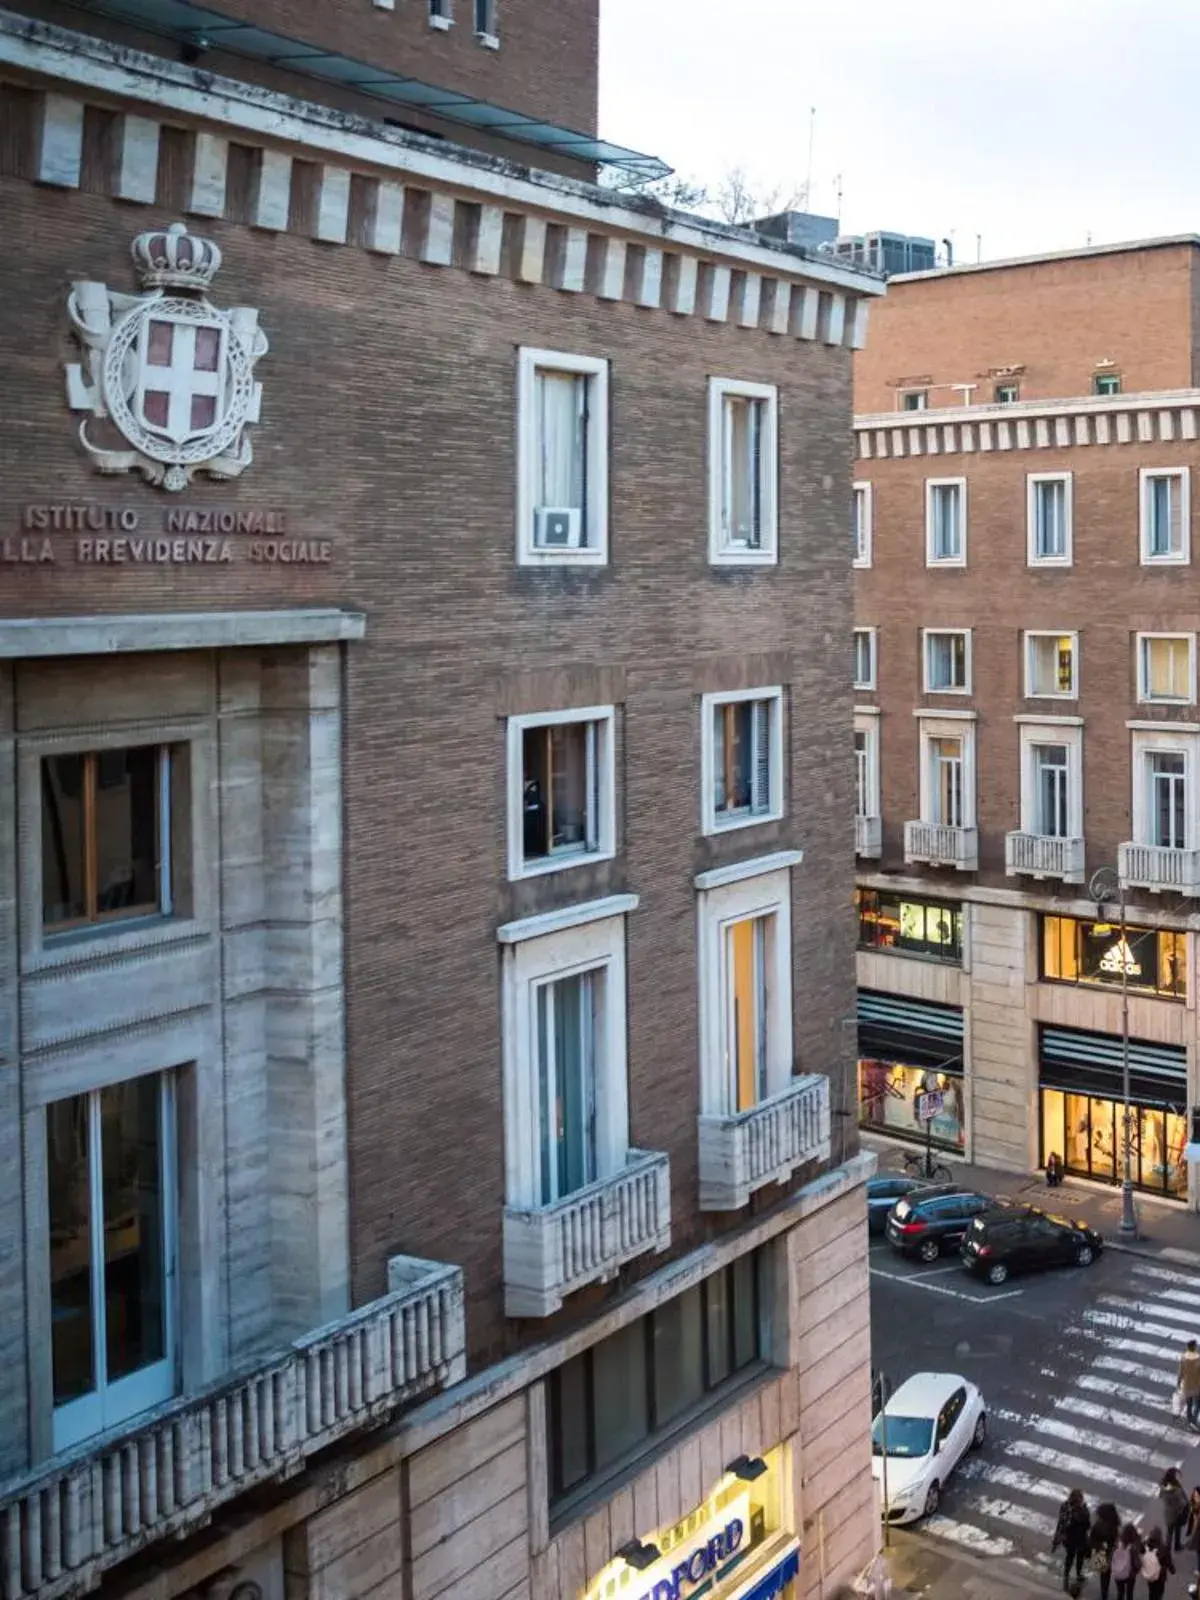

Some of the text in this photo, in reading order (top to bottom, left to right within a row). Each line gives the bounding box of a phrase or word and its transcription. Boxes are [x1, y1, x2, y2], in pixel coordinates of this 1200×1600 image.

[26, 503, 287, 534] ISTITUTO NAZIONALE
[78, 538, 233, 562] PREVIDENZA
[250, 540, 332, 563] SOCIALE
[639, 1517, 744, 1600] DFORD
